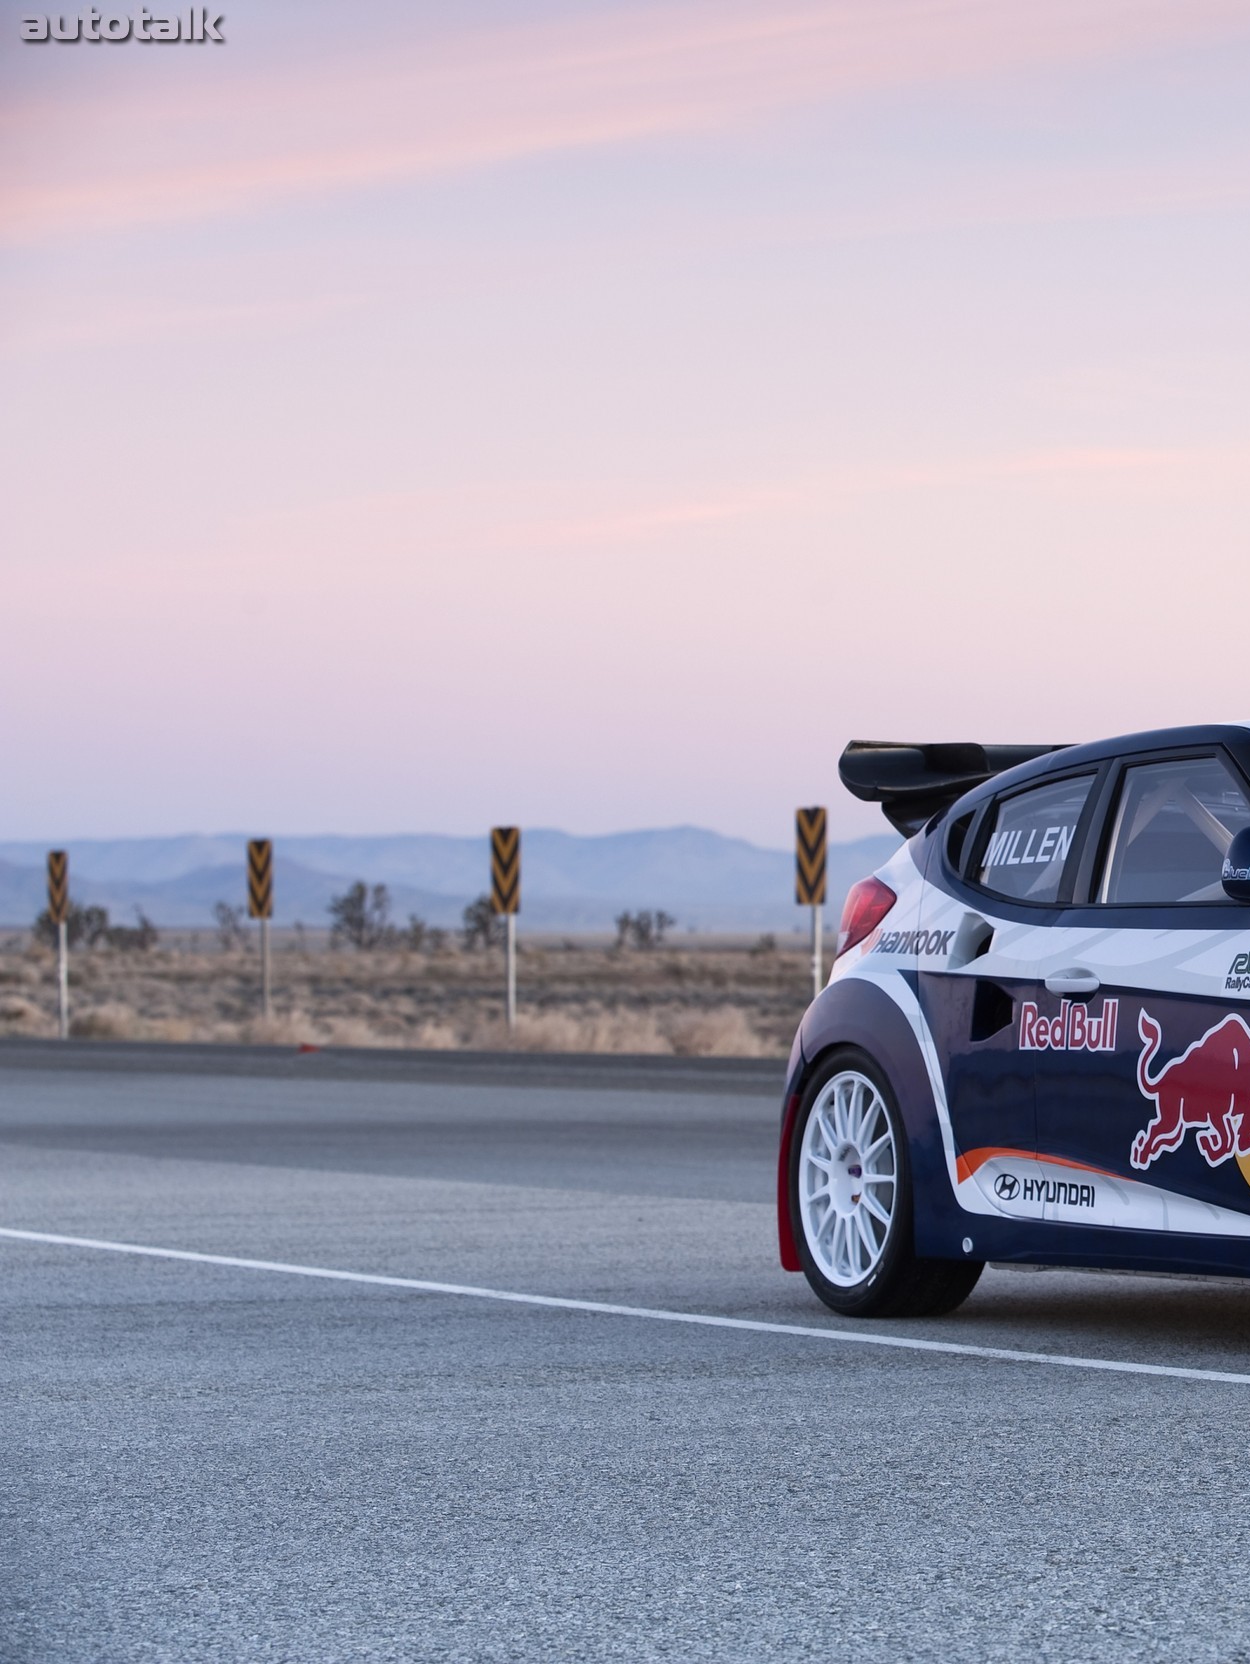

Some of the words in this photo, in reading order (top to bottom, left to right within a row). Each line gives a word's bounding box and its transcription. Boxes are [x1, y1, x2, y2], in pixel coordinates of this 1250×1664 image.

[980, 825, 1077, 868] MILLEN
[1019, 999, 1071, 1051] Red
[1068, 998, 1119, 1052] Bull
[1023, 1178, 1095, 1208] HYUNDAI
